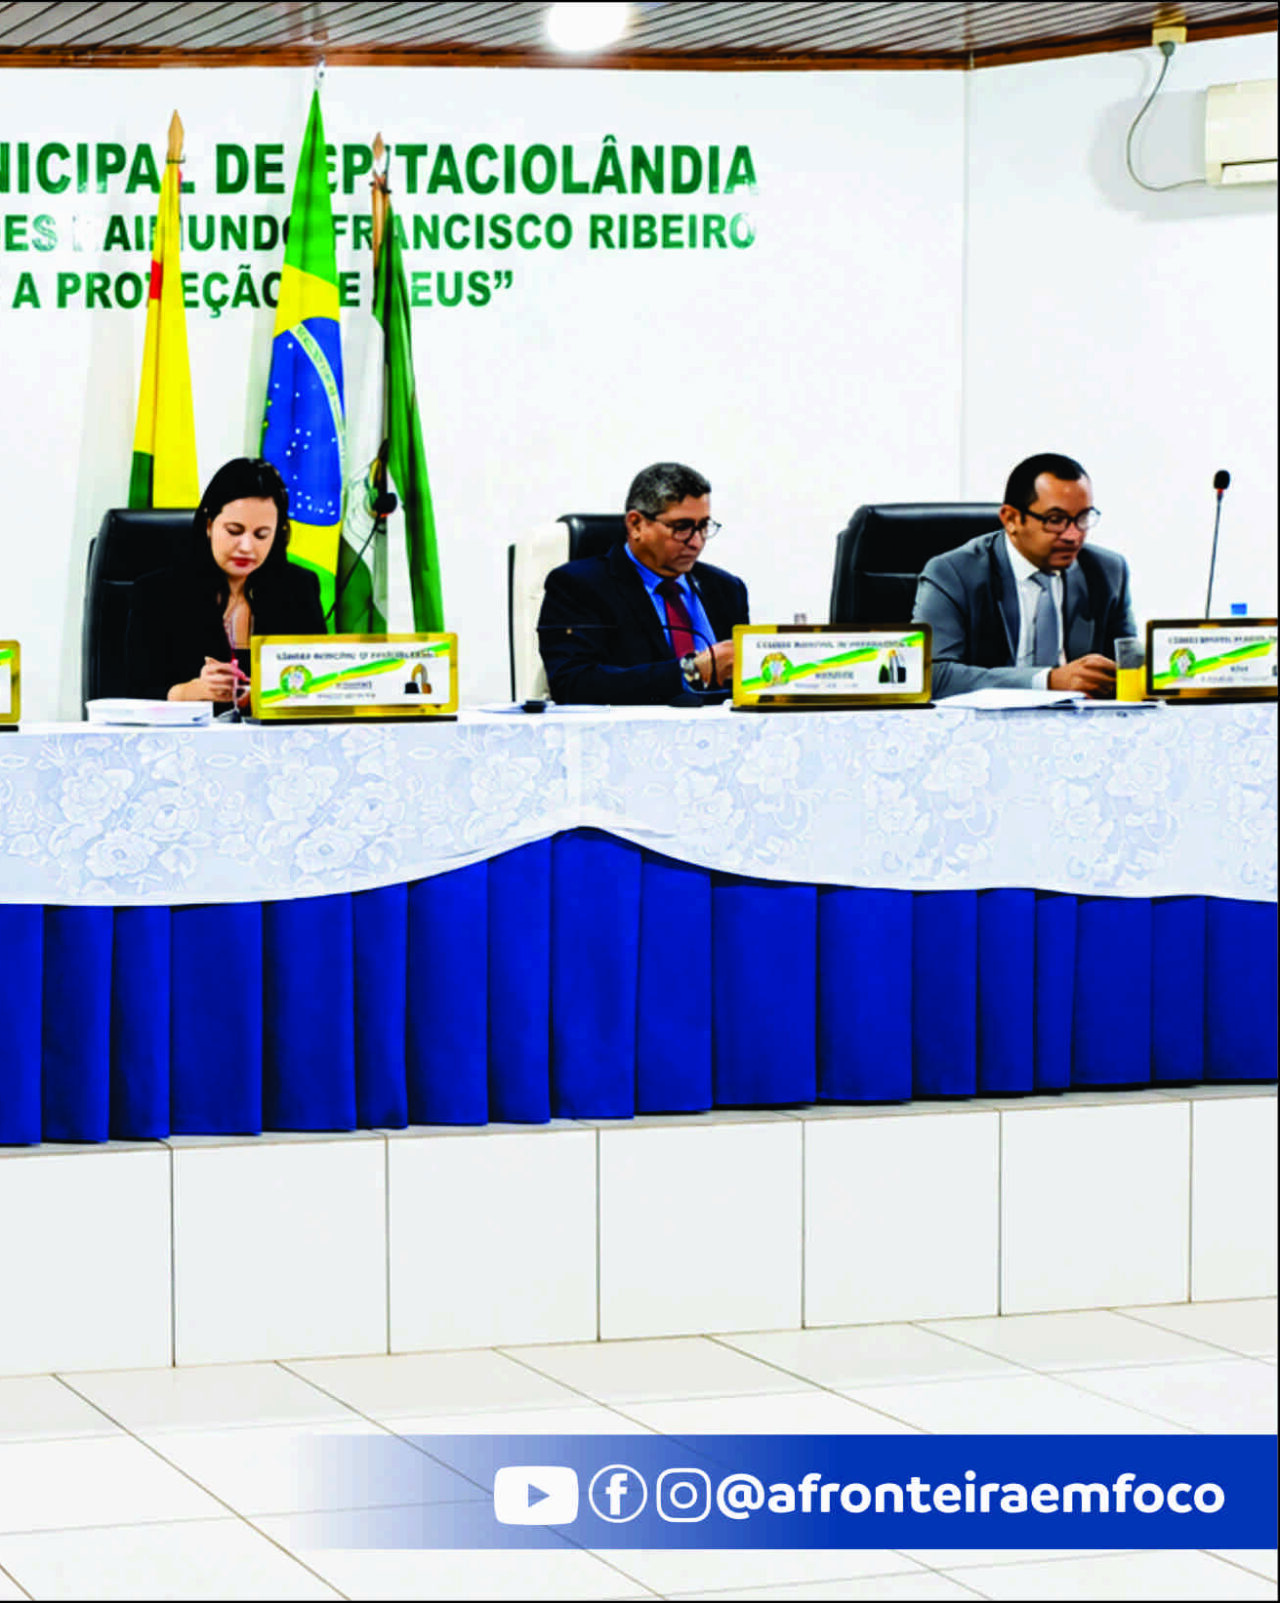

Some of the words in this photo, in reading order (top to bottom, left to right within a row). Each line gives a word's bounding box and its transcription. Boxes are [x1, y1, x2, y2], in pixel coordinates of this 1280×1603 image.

[215, 143, 285, 194] DE
[324, 134, 758, 195] PTACIOLÂNDIA
[72, 213, 290, 252] AIUND
[589, 213, 756, 250] RIBEIRO
[12, 271, 41, 309] A
[56, 263, 282, 318] PROEÇÃO
[410, 269, 514, 308] EUS”
